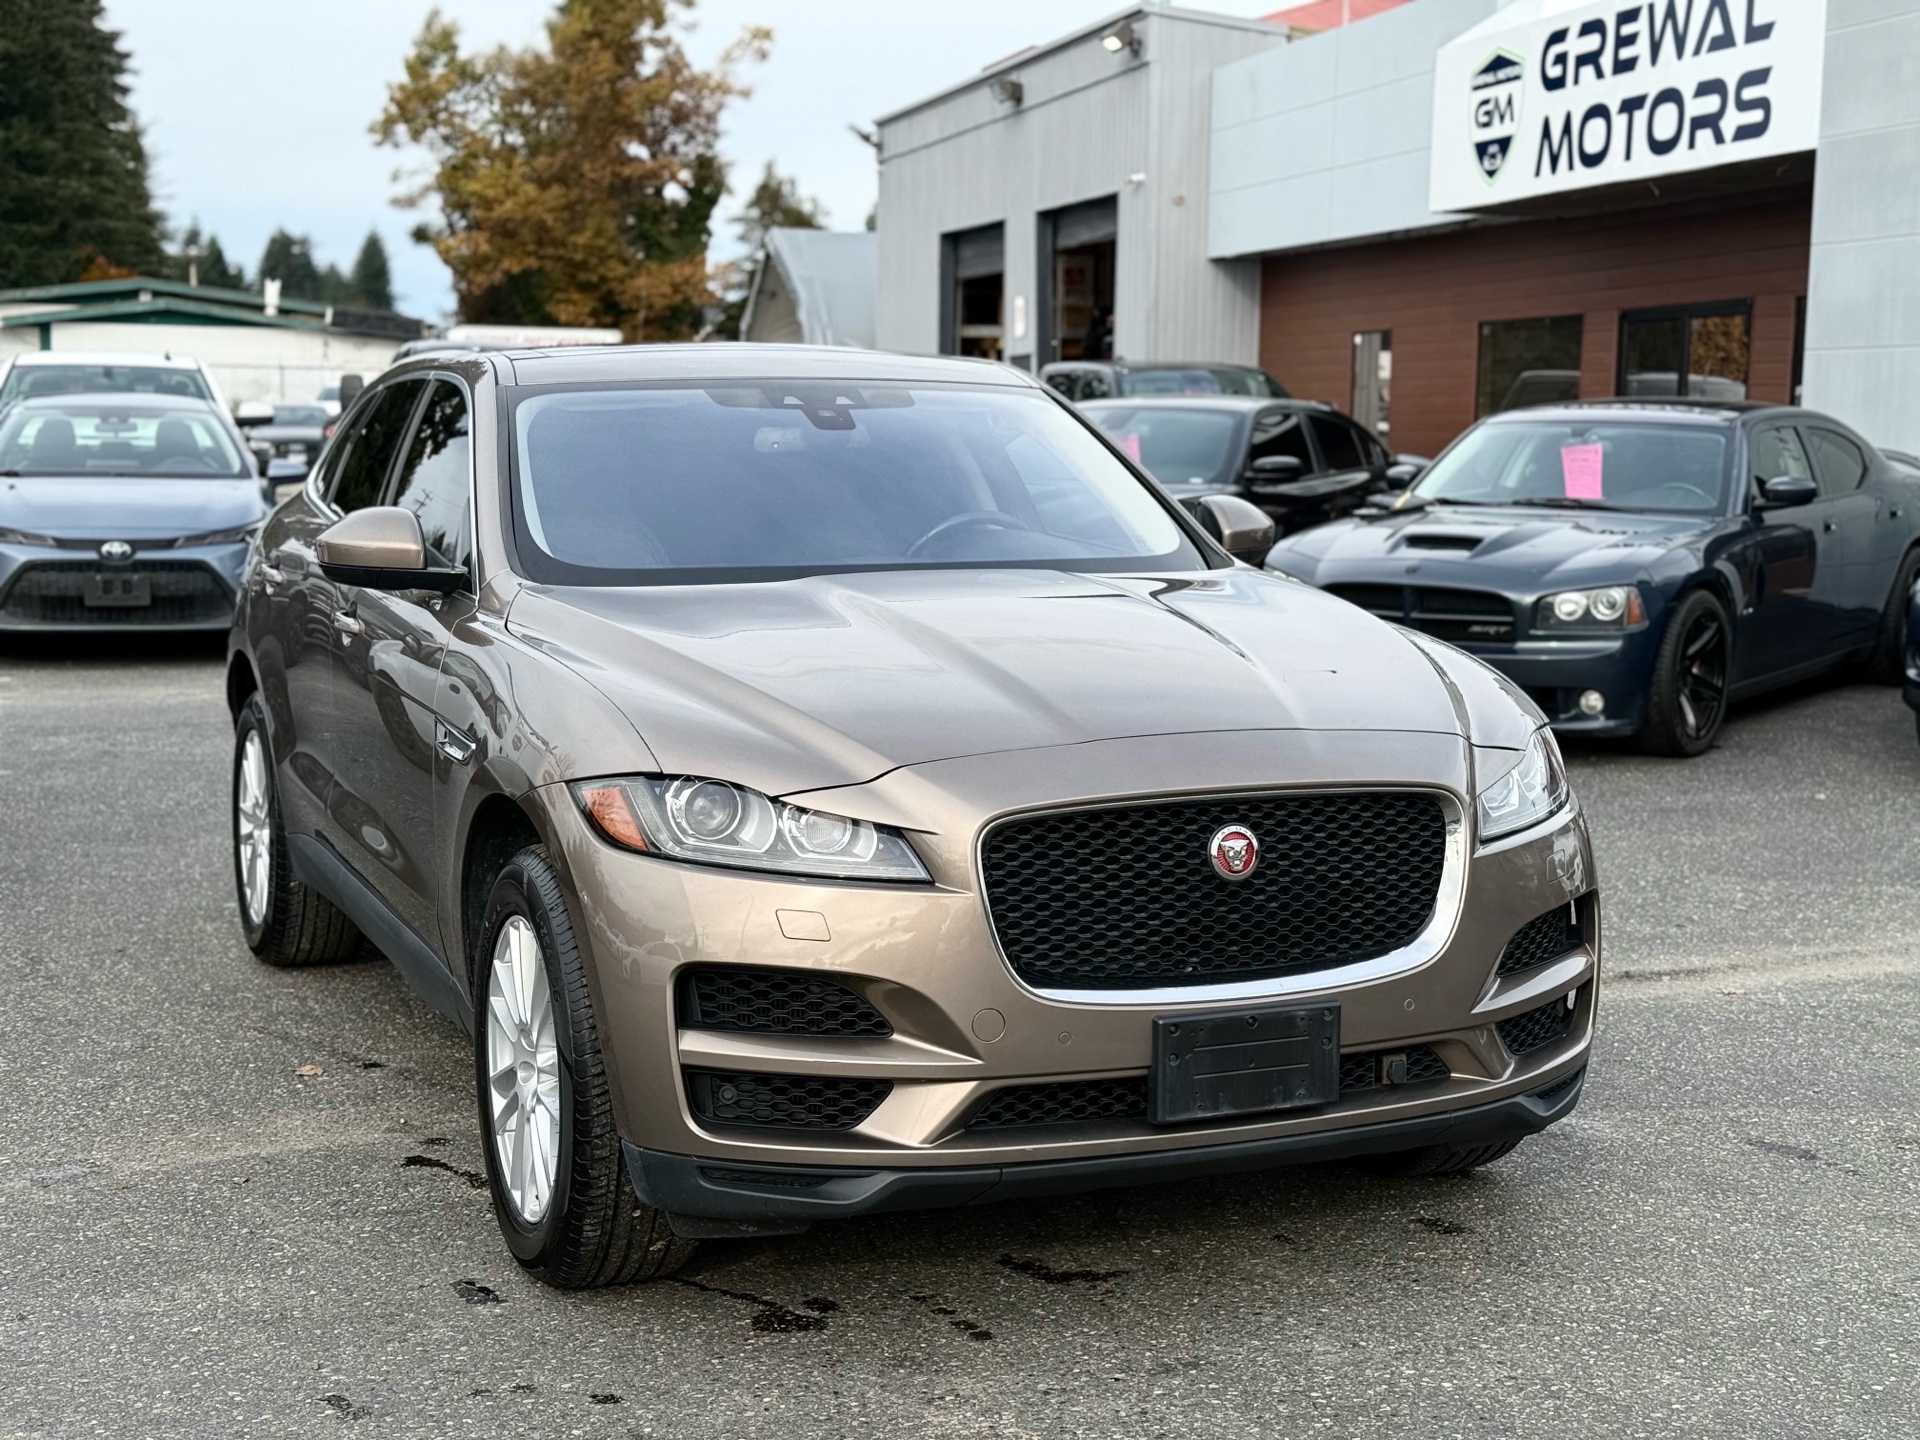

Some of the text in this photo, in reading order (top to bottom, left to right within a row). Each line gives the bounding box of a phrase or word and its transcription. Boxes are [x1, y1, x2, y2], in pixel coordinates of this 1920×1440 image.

[1541, 0, 1776, 92] GREWAL
[1475, 92, 1515, 128] GM
[1535, 65, 1773, 178] MOTORS
